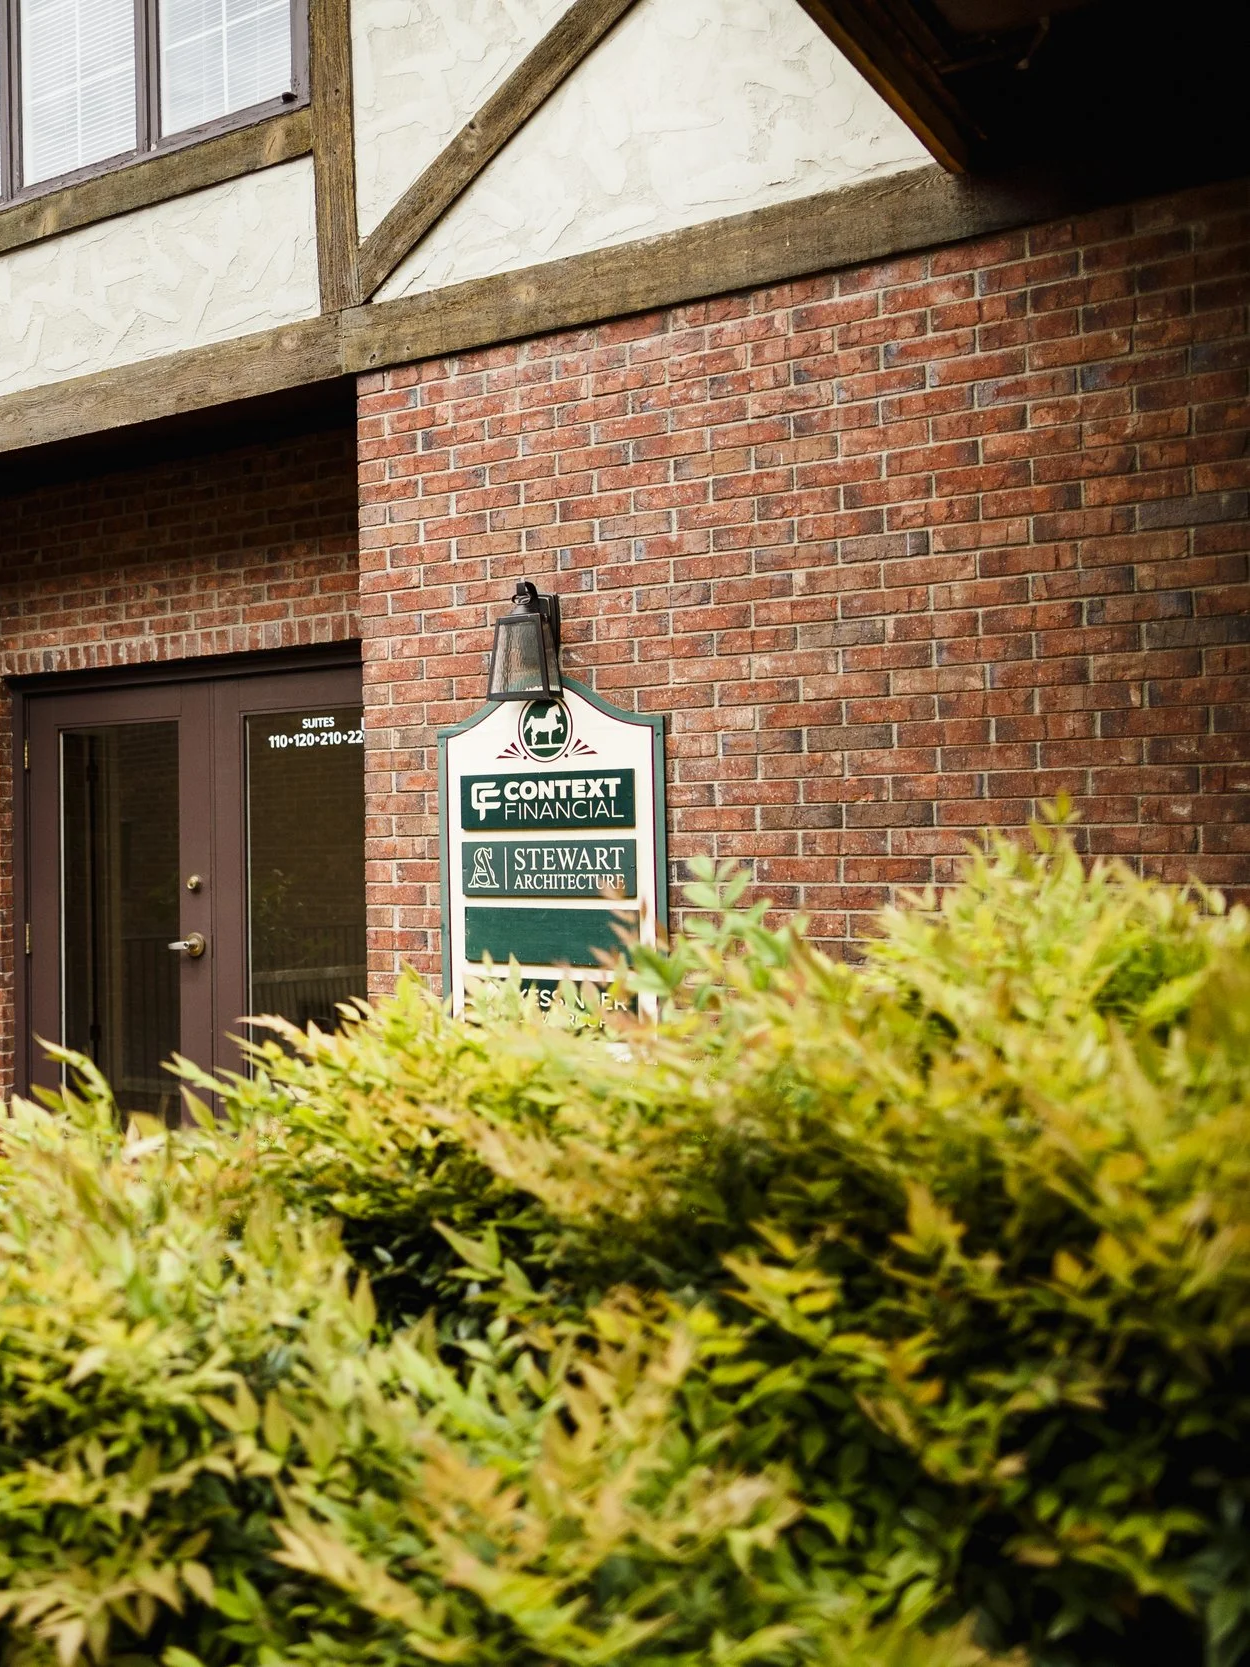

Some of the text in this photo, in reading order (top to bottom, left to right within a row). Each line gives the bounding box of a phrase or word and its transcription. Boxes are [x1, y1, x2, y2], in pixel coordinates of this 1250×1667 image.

[302, 717, 335, 729] SUITES
[504, 777, 621, 801] CONTEXT
[504, 799, 625, 820] FINANCIAL
[514, 846, 625, 871] STEWART
[513, 872, 626, 890] ARCHITECTURE
